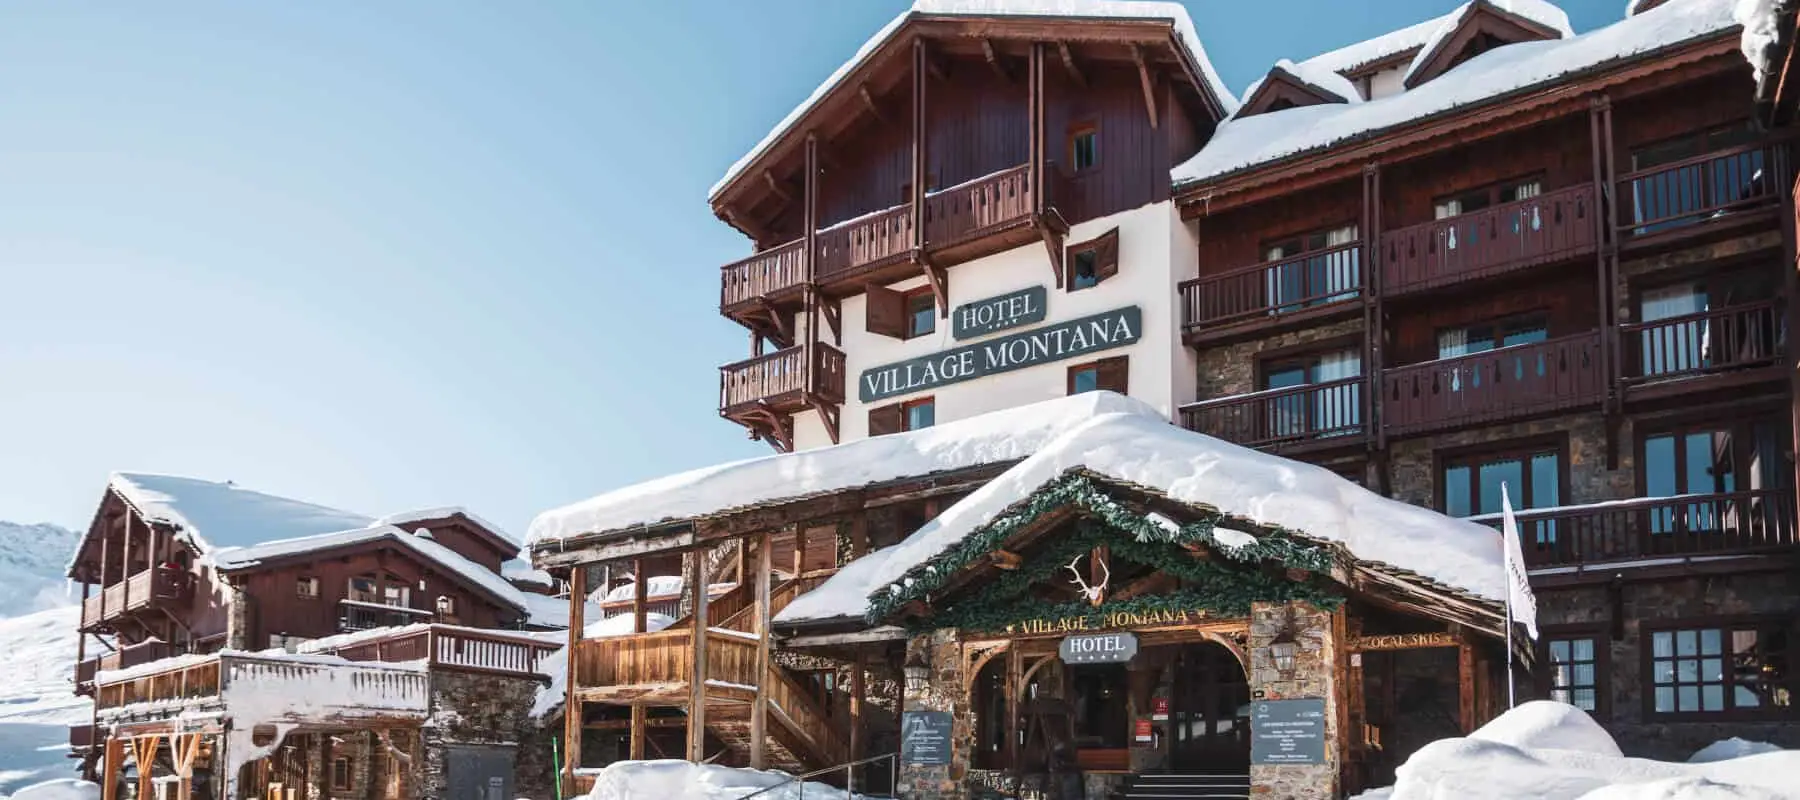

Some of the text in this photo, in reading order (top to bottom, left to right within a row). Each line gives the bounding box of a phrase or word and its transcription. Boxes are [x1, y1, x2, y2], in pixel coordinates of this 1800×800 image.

[962, 294, 1038, 331] HOTEL
[865, 314, 1134, 398] VILLAGE MONTANA
[1021, 608, 1189, 634] VILLAGE MONTANA
[1070, 636, 1126, 653] HOTEL
[1412, 633, 1441, 646] SKIS
